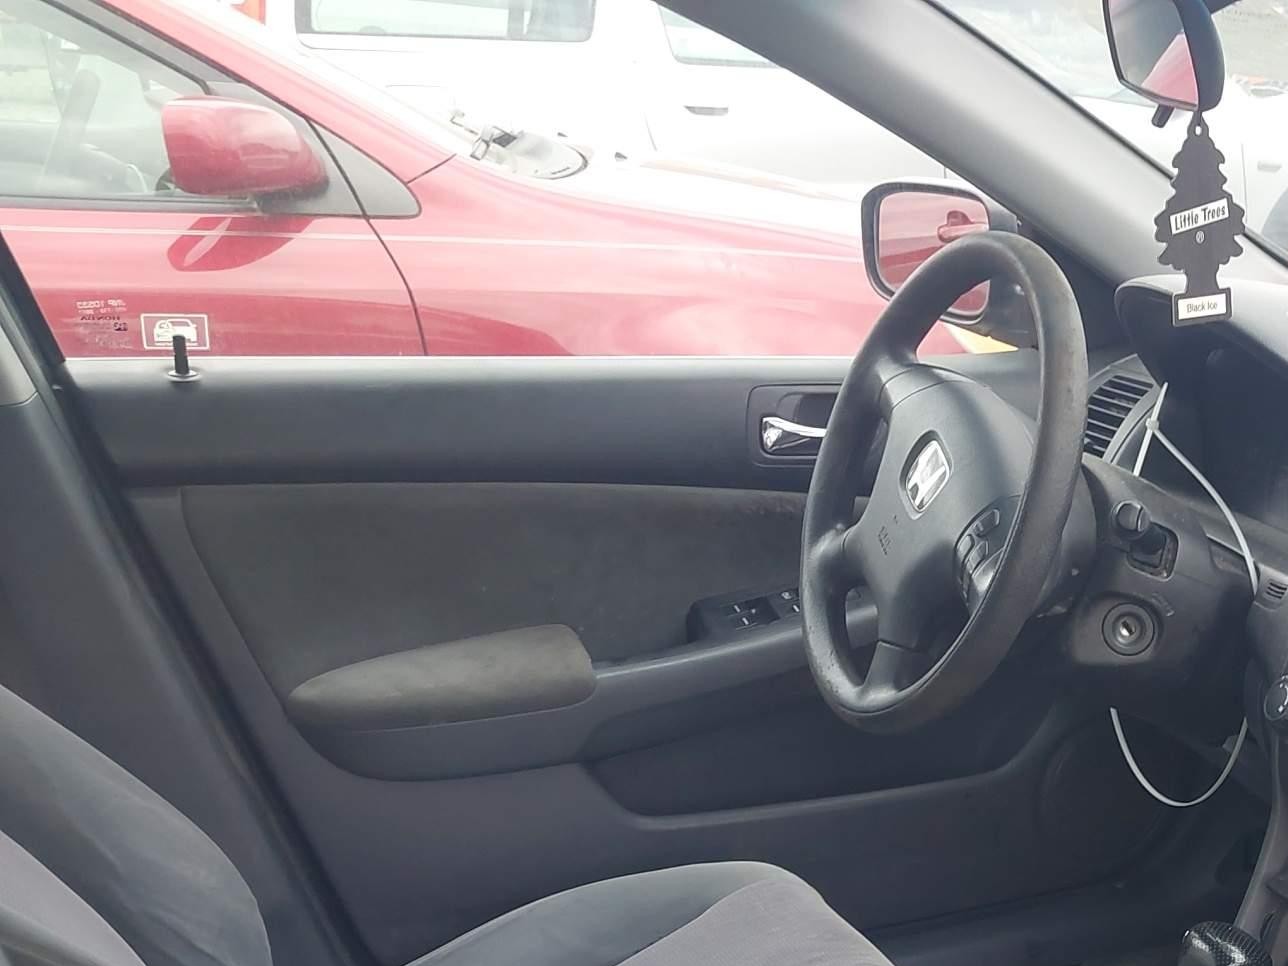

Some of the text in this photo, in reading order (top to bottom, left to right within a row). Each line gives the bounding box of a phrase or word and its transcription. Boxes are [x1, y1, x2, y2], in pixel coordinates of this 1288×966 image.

[1174, 205, 1226, 231] Little Trees
[1186, 302, 1218, 313] Black Ice
